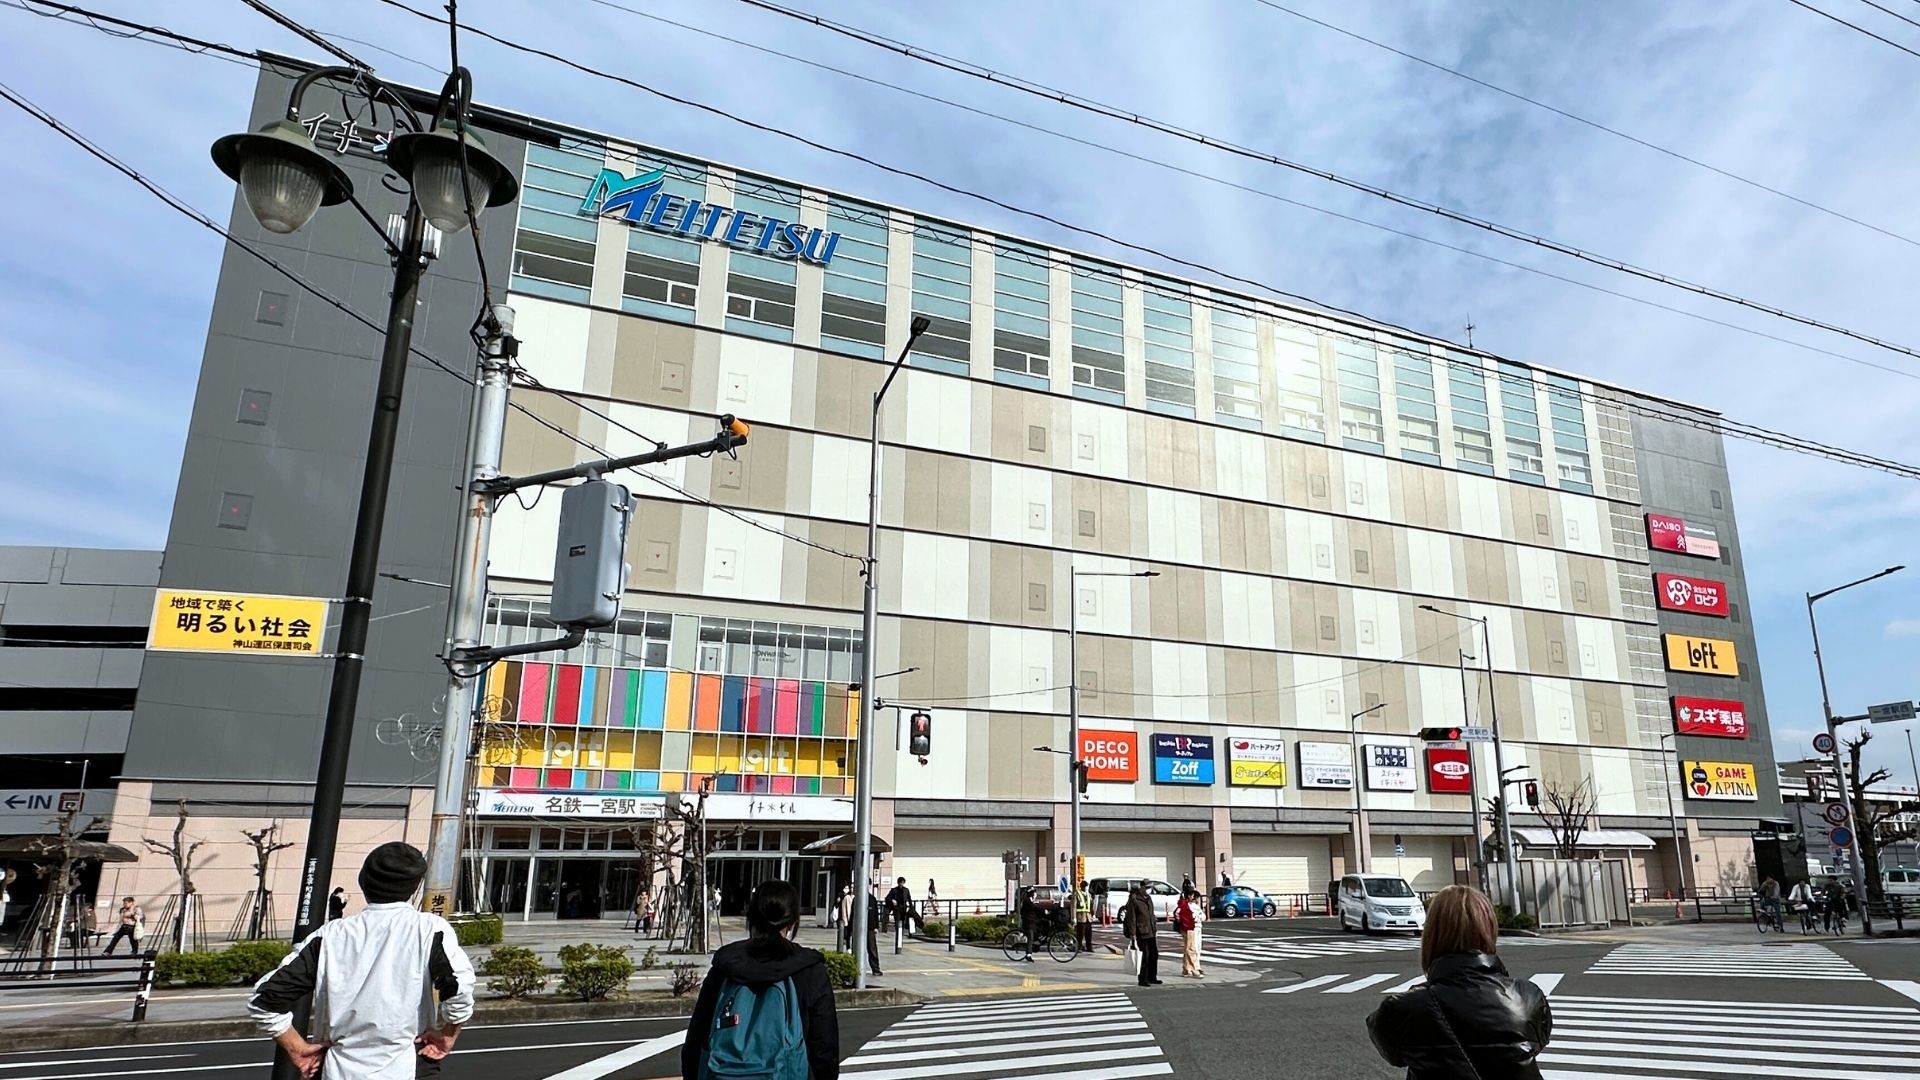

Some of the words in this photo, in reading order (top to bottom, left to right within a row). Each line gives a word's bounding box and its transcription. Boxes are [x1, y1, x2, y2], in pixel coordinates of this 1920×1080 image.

[580, 165, 843, 265] MEITETSU
[1652, 519, 1681, 532] DAISO
[170, 596, 246, 612] 地域で築く
[1694, 594, 1718, 606] ロピア
[176, 612, 312, 639] 明るい社会
[1693, 708, 1745, 726] スギ薬局
[1084, 740, 1129, 755] DECO
[1250, 744, 1281, 752] ハートアップ
[1819, 738, 1831, 748] 40
[1084, 755, 1129, 770] HOME
[1171, 761, 1199, 776] Zoff
[1375, 757, 1406, 767] のトライ
[1715, 767, 1747, 779] GAME
[1715, 781, 1755, 796] APINA
[27, 795, 52, 809] IN
[491, 801, 535, 814] MEITETSU
[544, 796, 637, 815] 名鉄一宮駅
